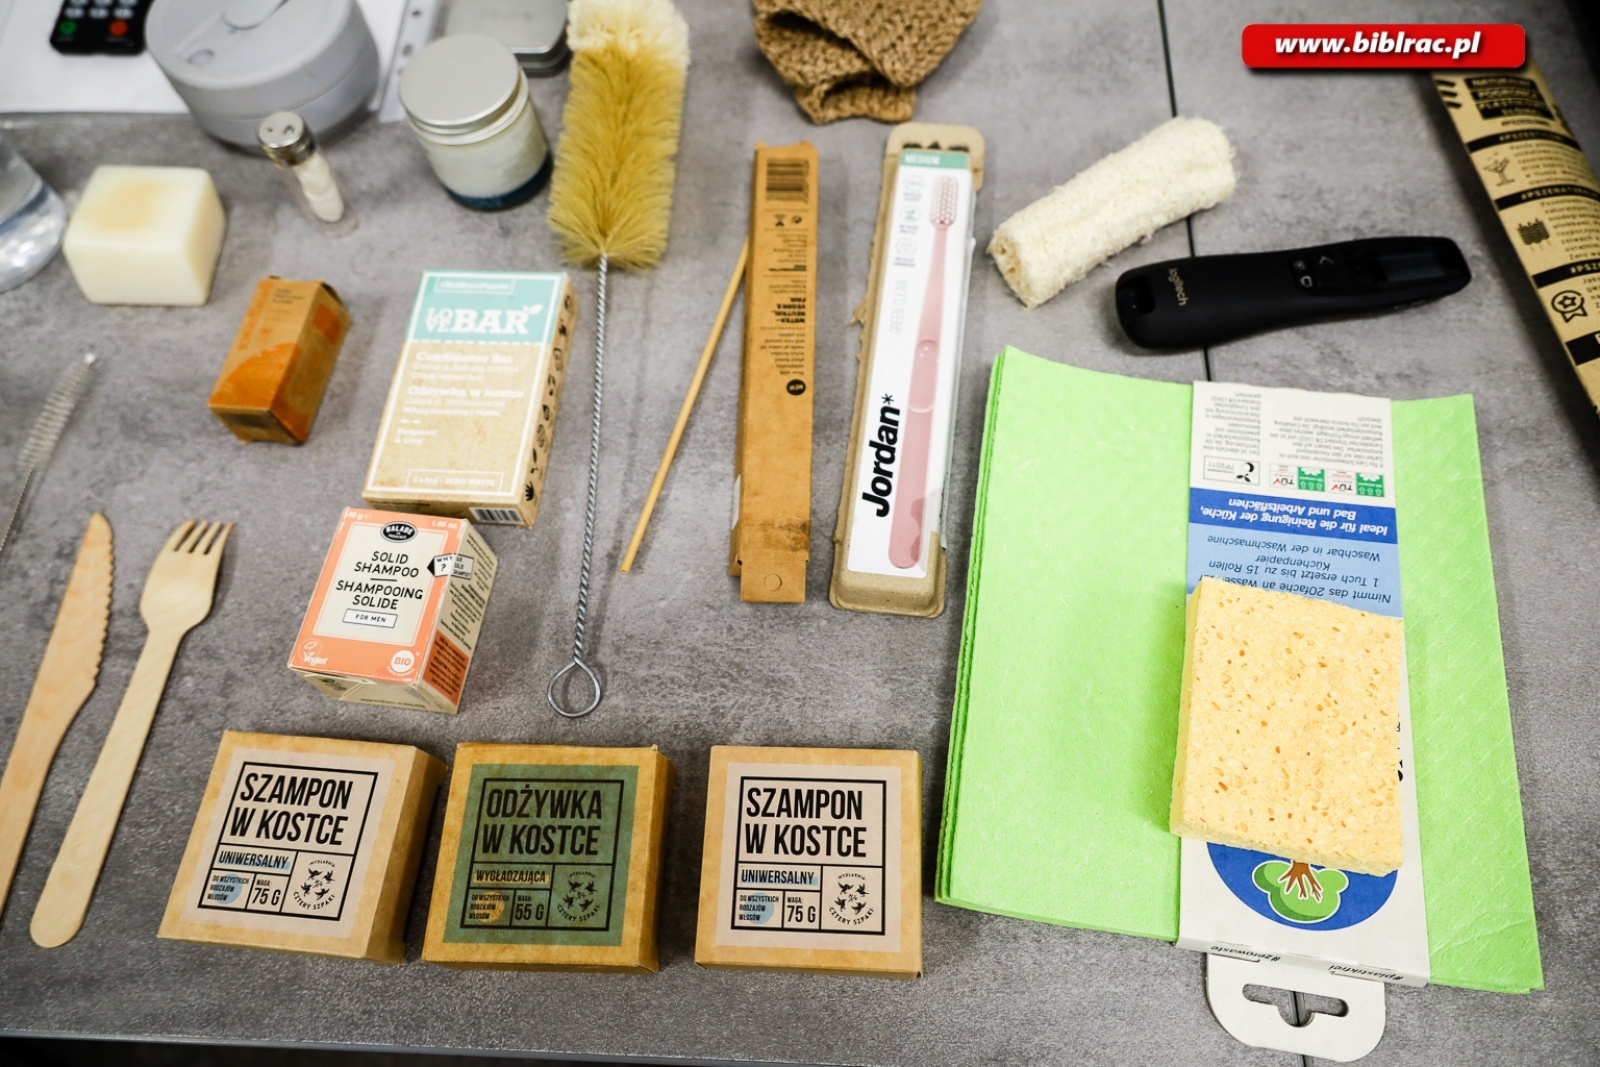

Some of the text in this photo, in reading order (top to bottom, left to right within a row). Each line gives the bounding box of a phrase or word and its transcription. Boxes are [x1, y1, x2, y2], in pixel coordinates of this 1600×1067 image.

[904, 153, 940, 165] MEDIUM
[1168, 268, 1189, 306] logitech
[451, 308, 530, 335] BAR
[862, 404, 900, 518] Jordan
[1273, 478, 1294, 486] TÜV
[1331, 483, 1353, 492] TÜV
[1228, 498, 1356, 521] Bad und Arbeitsflächen
[1200, 506, 1388, 536] Ideal für die Reinigung der Küche,
[1207, 535, 1380, 562] Waschbar in der Waschmaschine
[371, 551, 409, 564] SOLID
[1255, 554, 1330, 571] Küchenpapier
[354, 562, 419, 578] SHAMPOO
[441, 563, 446, 571] ?
[1209, 561, 1379, 587] 1 Tuch ersetzt bis zu 15 Rollen
[336, 580, 423, 599] SHAMPOOING
[1222, 576, 1257, 588] Wasse
[1262, 581, 1275, 589] an
[1279, 583, 1325, 596] 20fache
[1329, 587, 1349, 598] das
[1353, 591, 1391, 603] Nimmt
[353, 594, 398, 610] SOLIDE
[394, 657, 411, 666] BIO
[240, 772, 353, 809] SZAMPON
[486, 784, 602, 819] ODŻYWKA
[746, 788, 862, 820] SZAMPON
[230, 807, 348, 845] W KOSTCE
[481, 824, 601, 856] W KOSTCE
[745, 823, 867, 857] W KOSTCE
[218, 851, 289, 869] UNIWERSALNY
[476, 869, 545, 884] WYGŁADZAJĄCA
[741, 869, 814, 885] UNIWERSALNY
[253, 888, 281, 905] 75 G
[515, 903, 544, 921] 55 G
[787, 905, 816, 923] 75 G
[1211, 945, 1281, 962] #zerowaste
[1328, 965, 1404, 981] #plastikfrei
